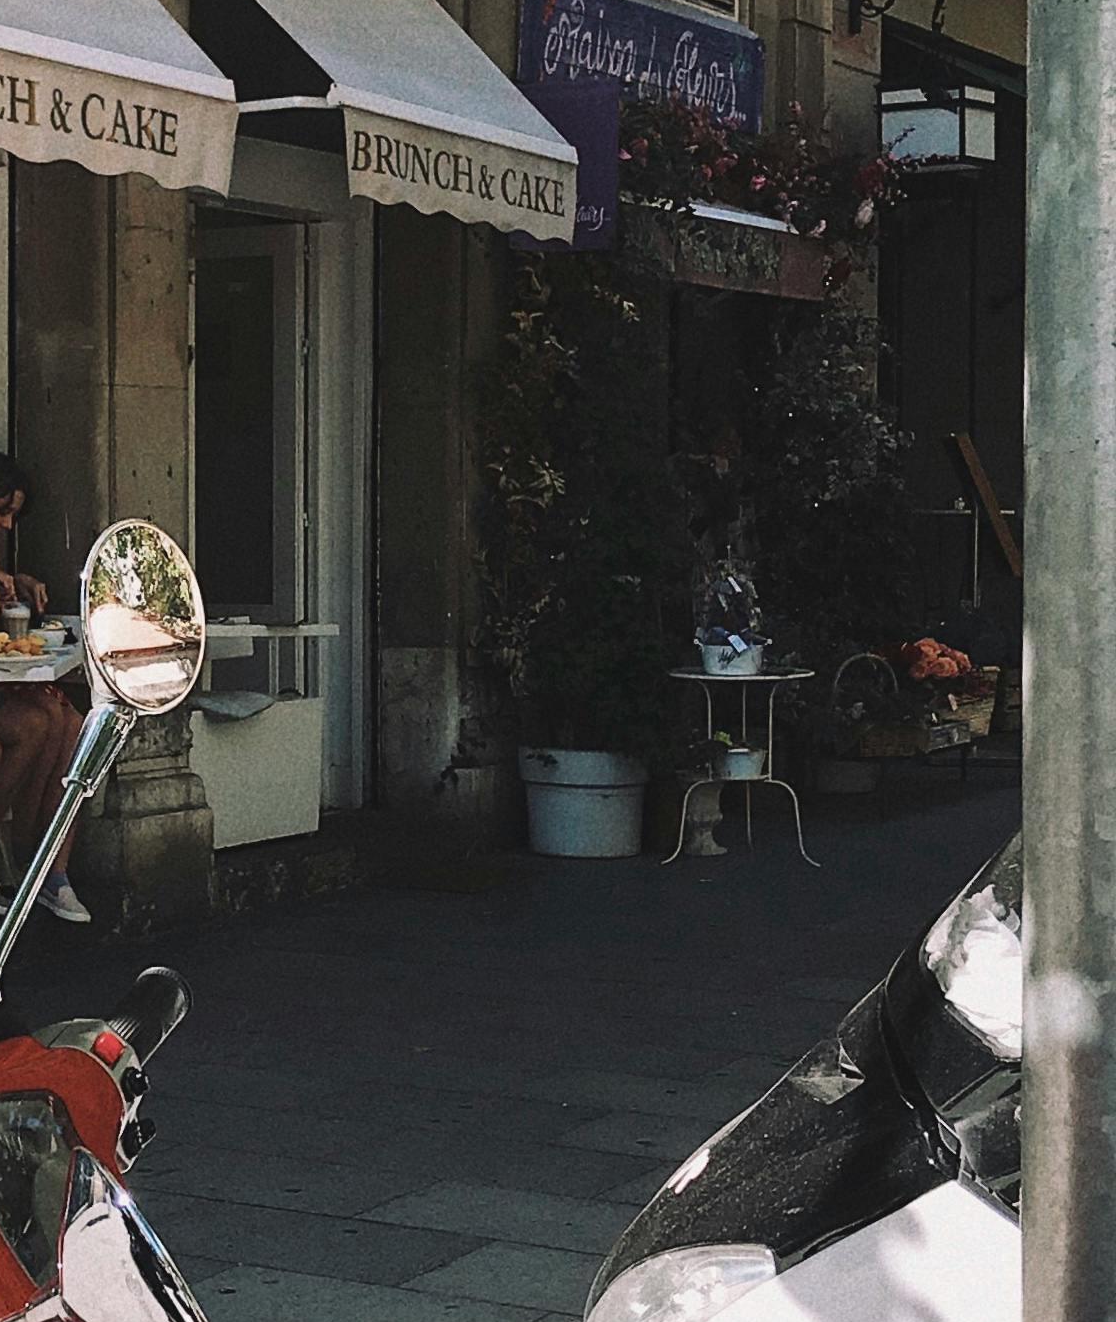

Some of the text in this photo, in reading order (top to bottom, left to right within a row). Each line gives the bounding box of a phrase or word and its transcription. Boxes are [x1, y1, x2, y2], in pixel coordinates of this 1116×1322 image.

[49, 87, 74, 134] &
[80, 93, 180, 157] CAKE
[350, 130, 566, 217] BRUNCH & CAKE
